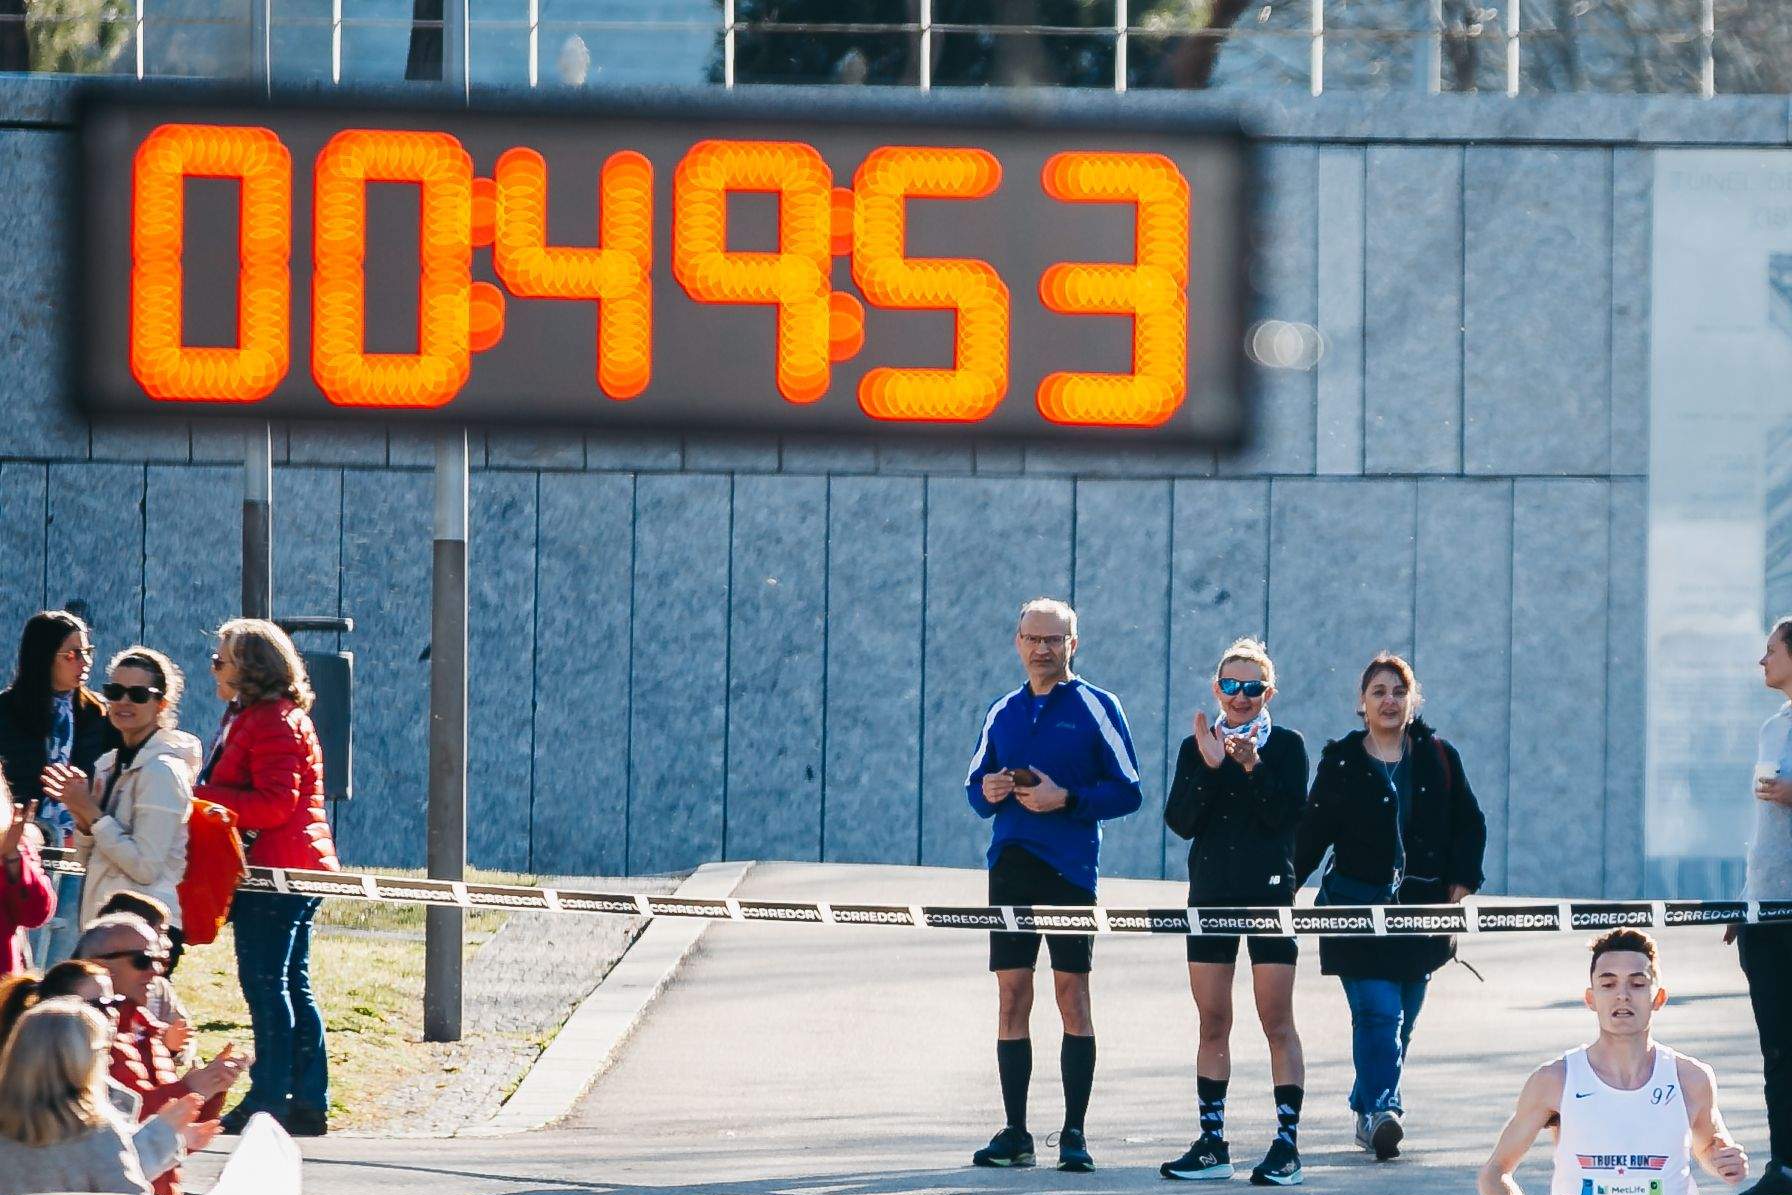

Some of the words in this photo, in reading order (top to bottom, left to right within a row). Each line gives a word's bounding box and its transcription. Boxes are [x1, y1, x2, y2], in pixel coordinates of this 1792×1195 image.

[1650, 1084, 1675, 1105] 97
[1630, 1154, 1650, 1167] RUN
[1611, 1185, 1646, 1194] MetLife
